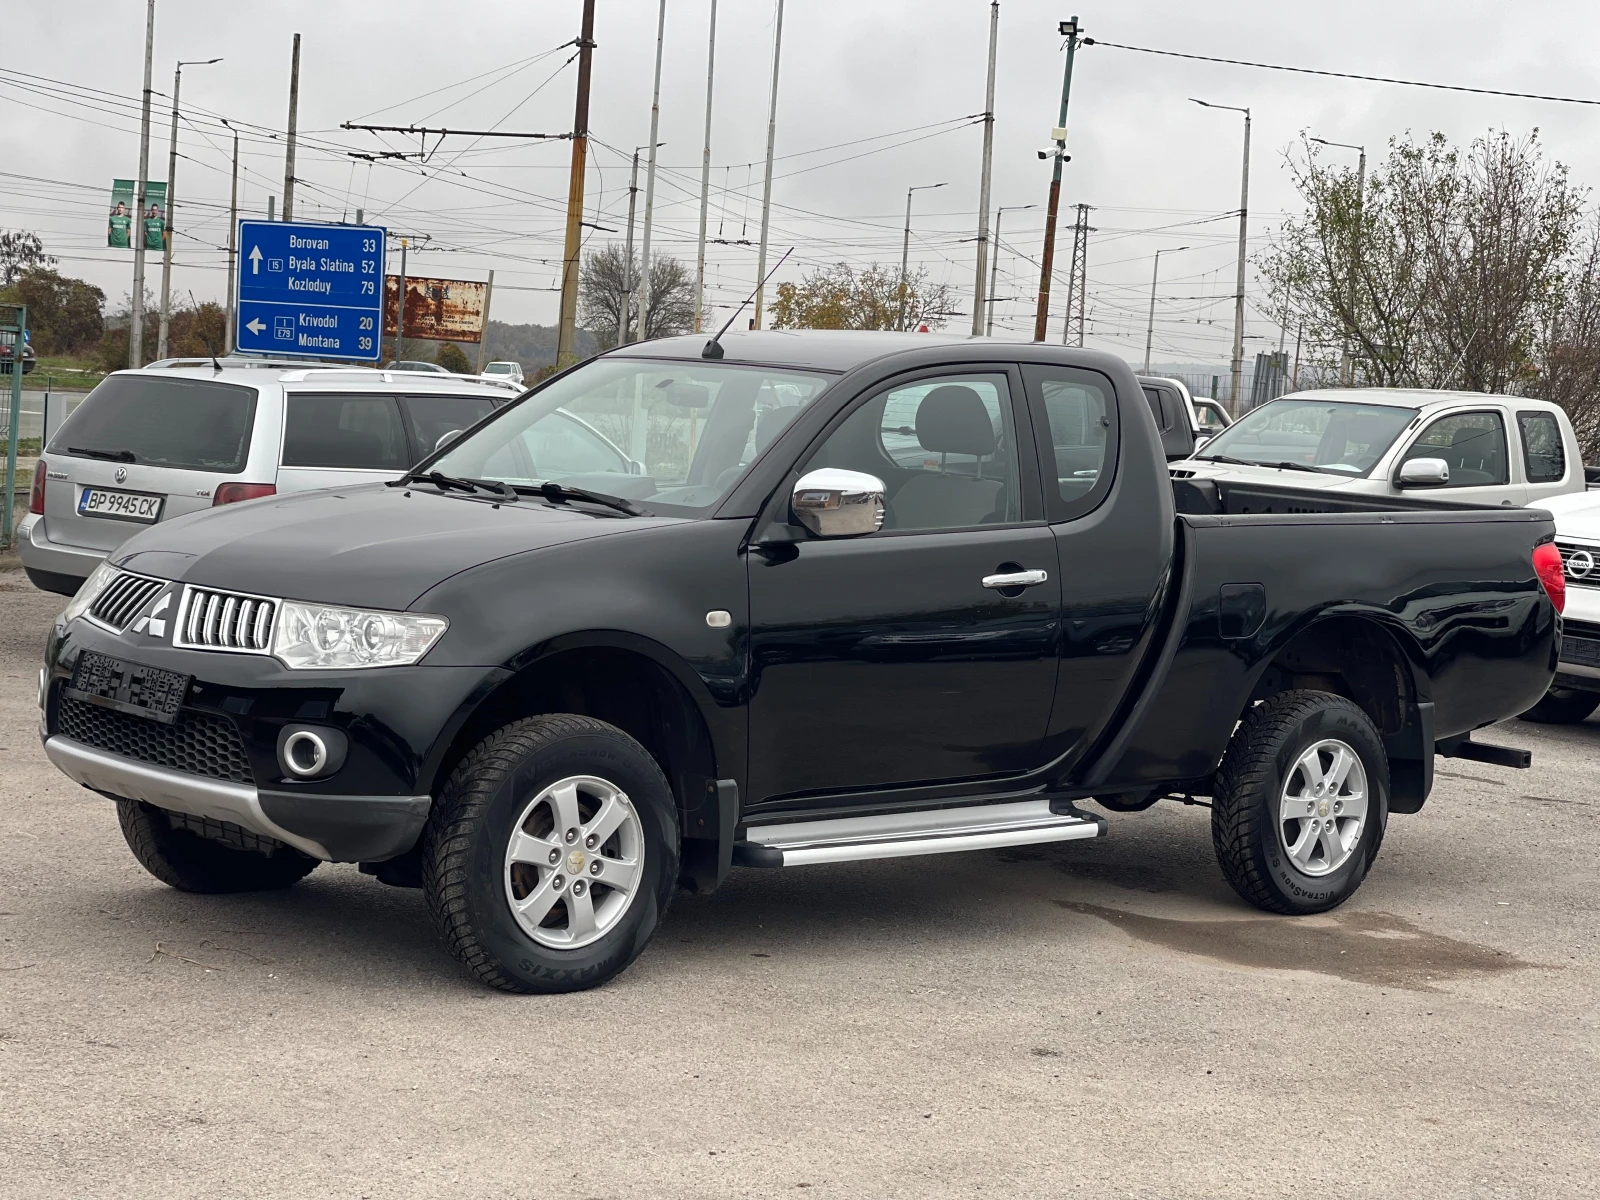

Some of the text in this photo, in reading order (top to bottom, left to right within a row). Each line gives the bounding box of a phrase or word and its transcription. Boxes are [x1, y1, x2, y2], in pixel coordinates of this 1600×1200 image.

[289, 235, 376, 253] Borovan 33
[272, 261, 279, 270] 15
[288, 255, 375, 274] Byala Slatina 52
[288, 276, 375, 295] Kozloduy 79
[299, 313, 373, 331] Krivodol 20
[277, 329, 291, 338] E79
[298, 332, 372, 351] Montana 39
[107, 494, 139, 514] 9945
[518, 955, 614, 982] MAXXIS
